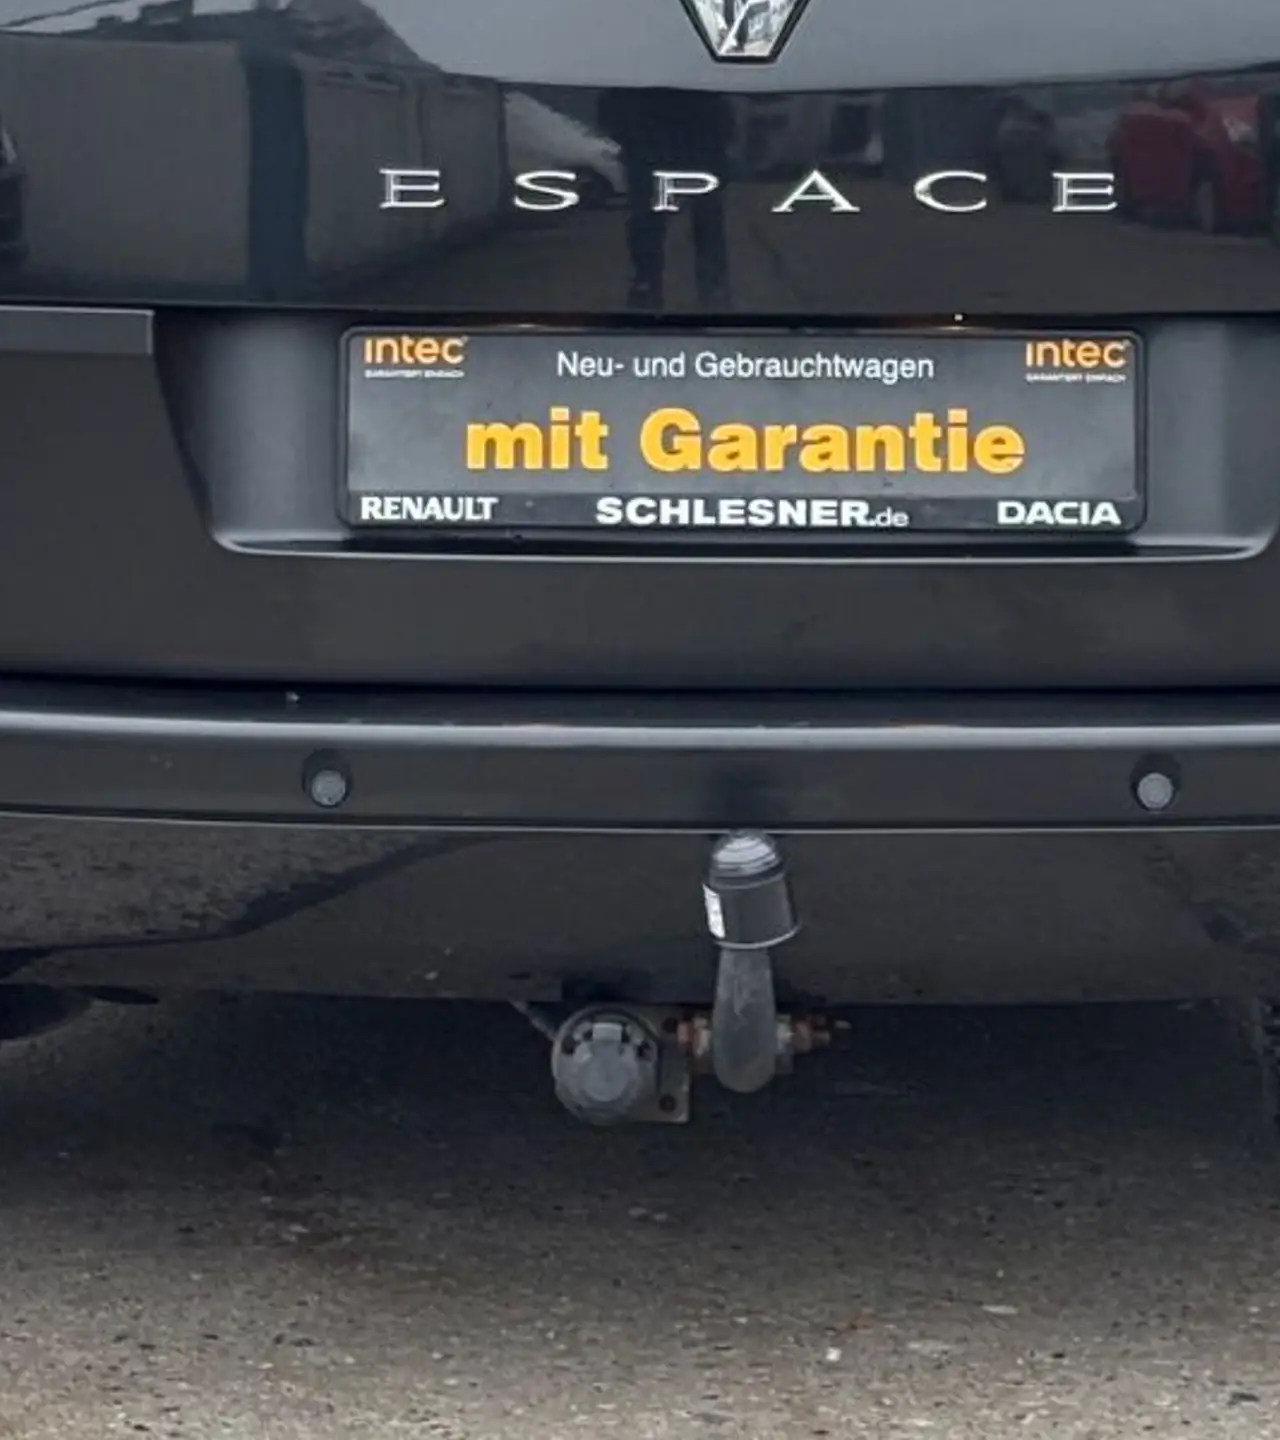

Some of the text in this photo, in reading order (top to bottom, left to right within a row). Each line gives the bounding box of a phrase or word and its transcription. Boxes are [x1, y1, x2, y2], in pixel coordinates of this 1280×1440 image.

[379, 168, 1118, 213] ESPACE
[364, 335, 465, 365] intec
[1025, 339, 1126, 368] intec
[556, 351, 935, 385] Neu- und Gebrauchtwagen
[466, 407, 1026, 474] mit Garantie
[360, 495, 499, 522] RENAULT
[996, 499, 1122, 526] DACIA
